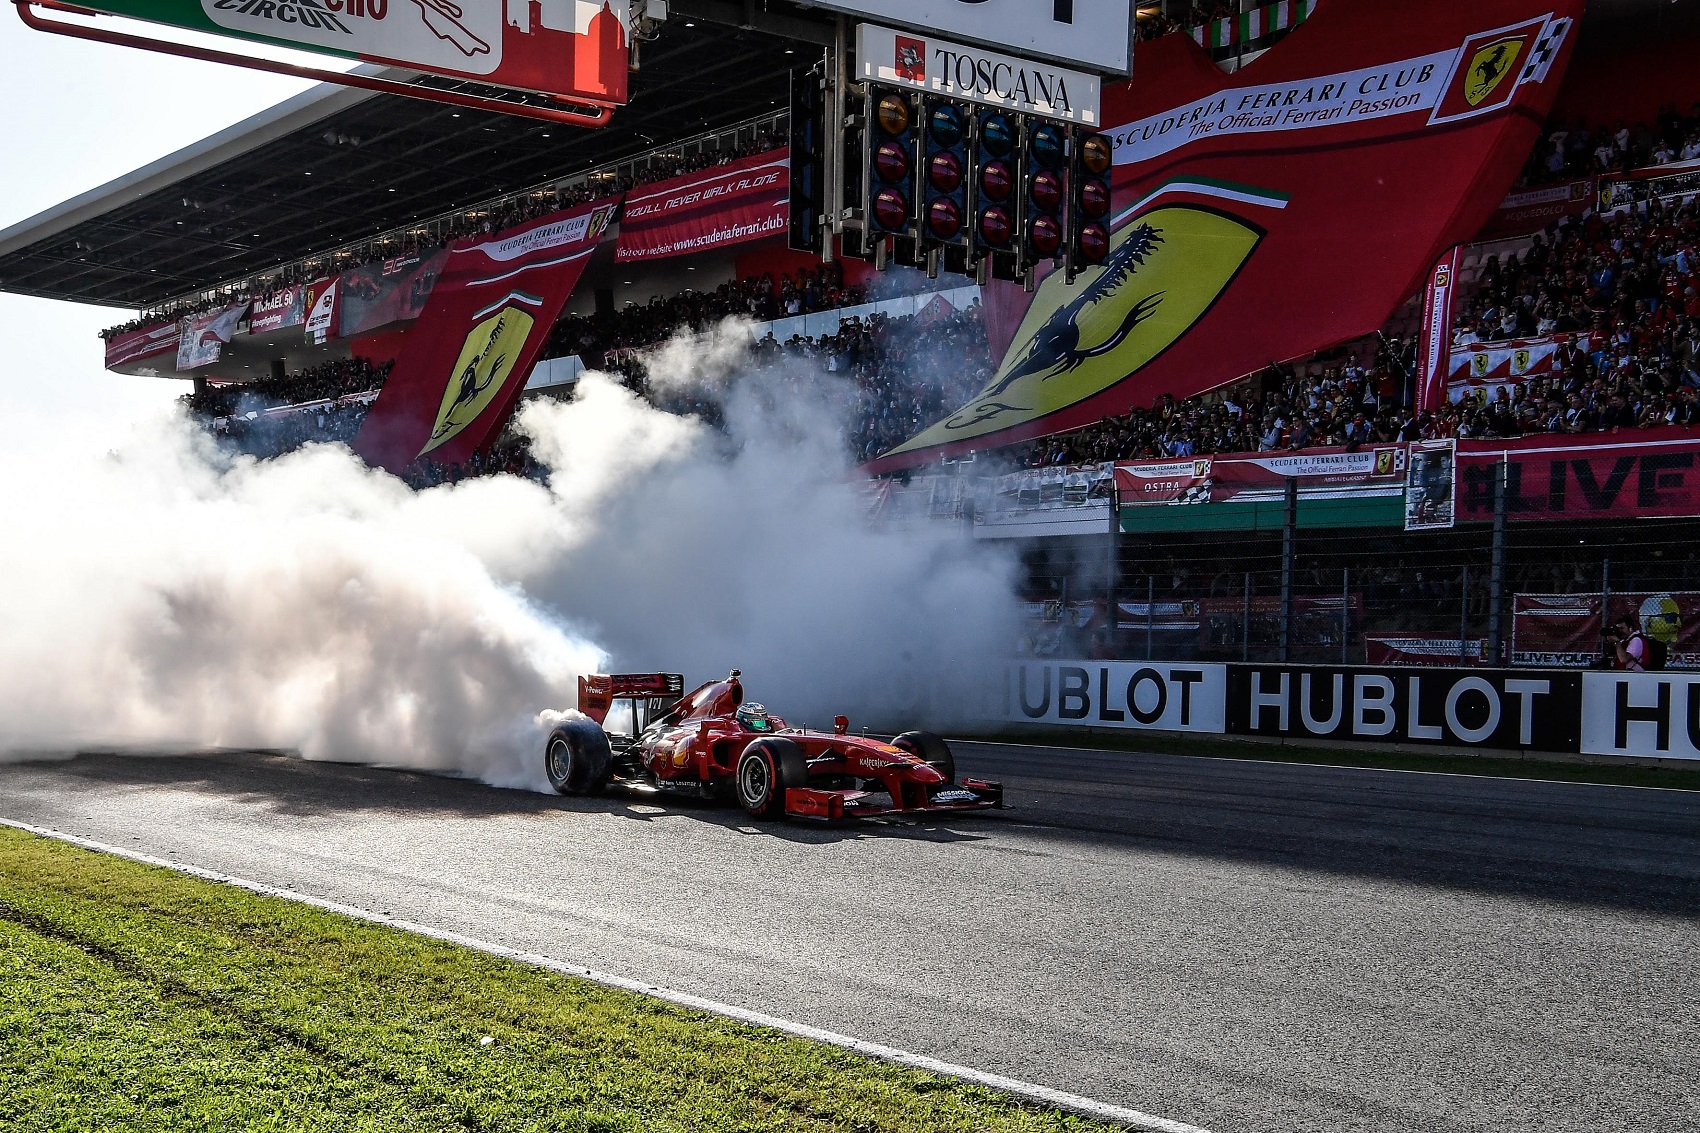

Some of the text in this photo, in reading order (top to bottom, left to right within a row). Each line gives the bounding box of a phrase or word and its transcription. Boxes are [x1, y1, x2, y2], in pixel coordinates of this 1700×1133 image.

[935, 49, 1072, 112] TOSCANA
[1112, 63, 1434, 150] SCUDERIA FERRARI CLUB
[1187, 91, 1421, 140] The Official Ferrari Passion
[664, 191, 701, 210] NEVER
[702, 181, 735, 200] WALK
[736, 171, 780, 190] ALONE
[498, 219, 585, 253] SCUDERIA FERRARI CLUB
[616, 246, 632, 258] Visit
[632, 248, 646, 256] our
[647, 243, 673, 255] website
[673, 213, 784, 251] www.scuderiaferrari.club
[1269, 454, 1369, 468] SCUDERIA FERRARI CLUB
[1348, 464, 1369, 472] Passion
[1144, 481, 1180, 493] OSTRA
[1004, 664, 1203, 726] UBLOT
[1249, 672, 1550, 745] HUBLOT
[936, 790, 970, 799] MISSION
